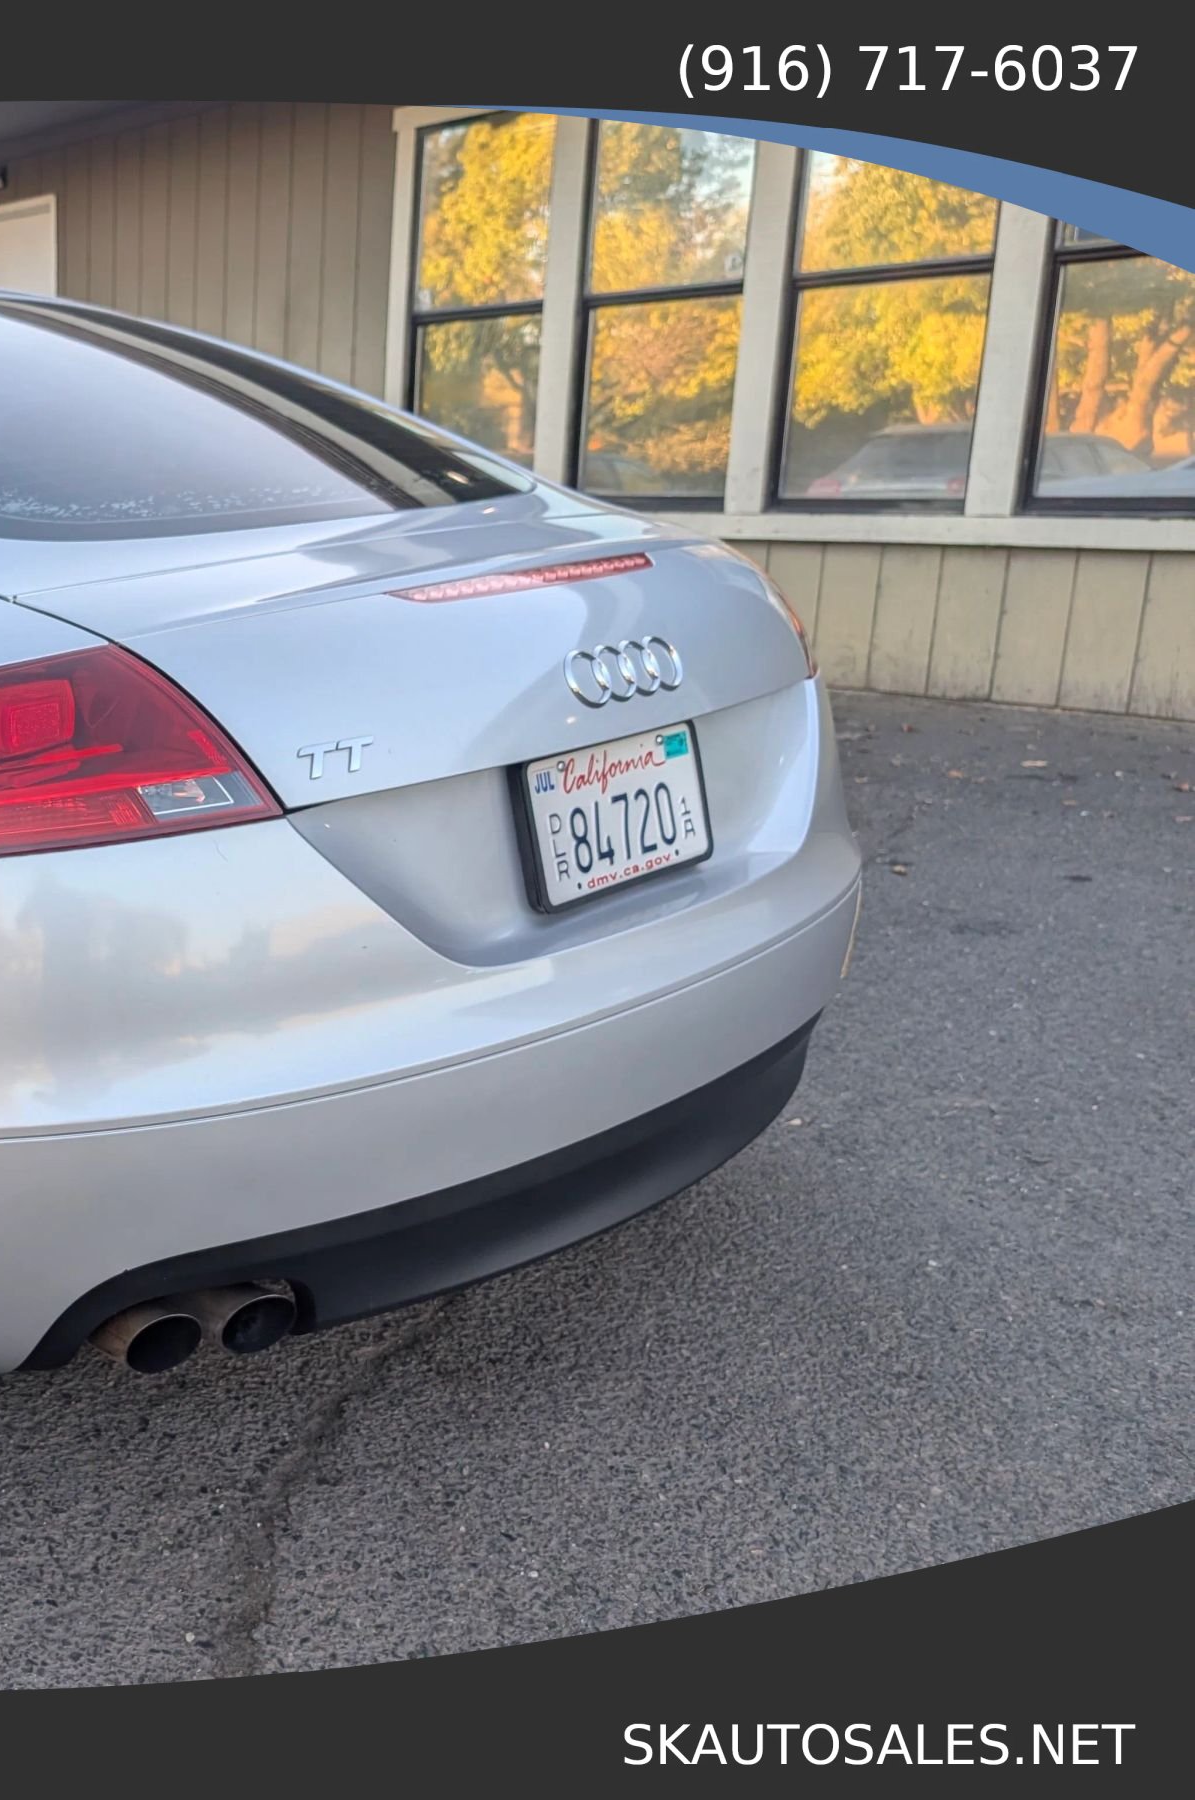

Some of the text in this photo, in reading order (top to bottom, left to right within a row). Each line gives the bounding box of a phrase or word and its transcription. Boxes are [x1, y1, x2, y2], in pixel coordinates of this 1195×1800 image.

[297, 735, 373, 780] TT
[563, 749, 666, 794] California
[534, 771, 555, 794] JUL
[570, 782, 677, 873] 84720
[587, 852, 671, 889] dmv.ca.gov
